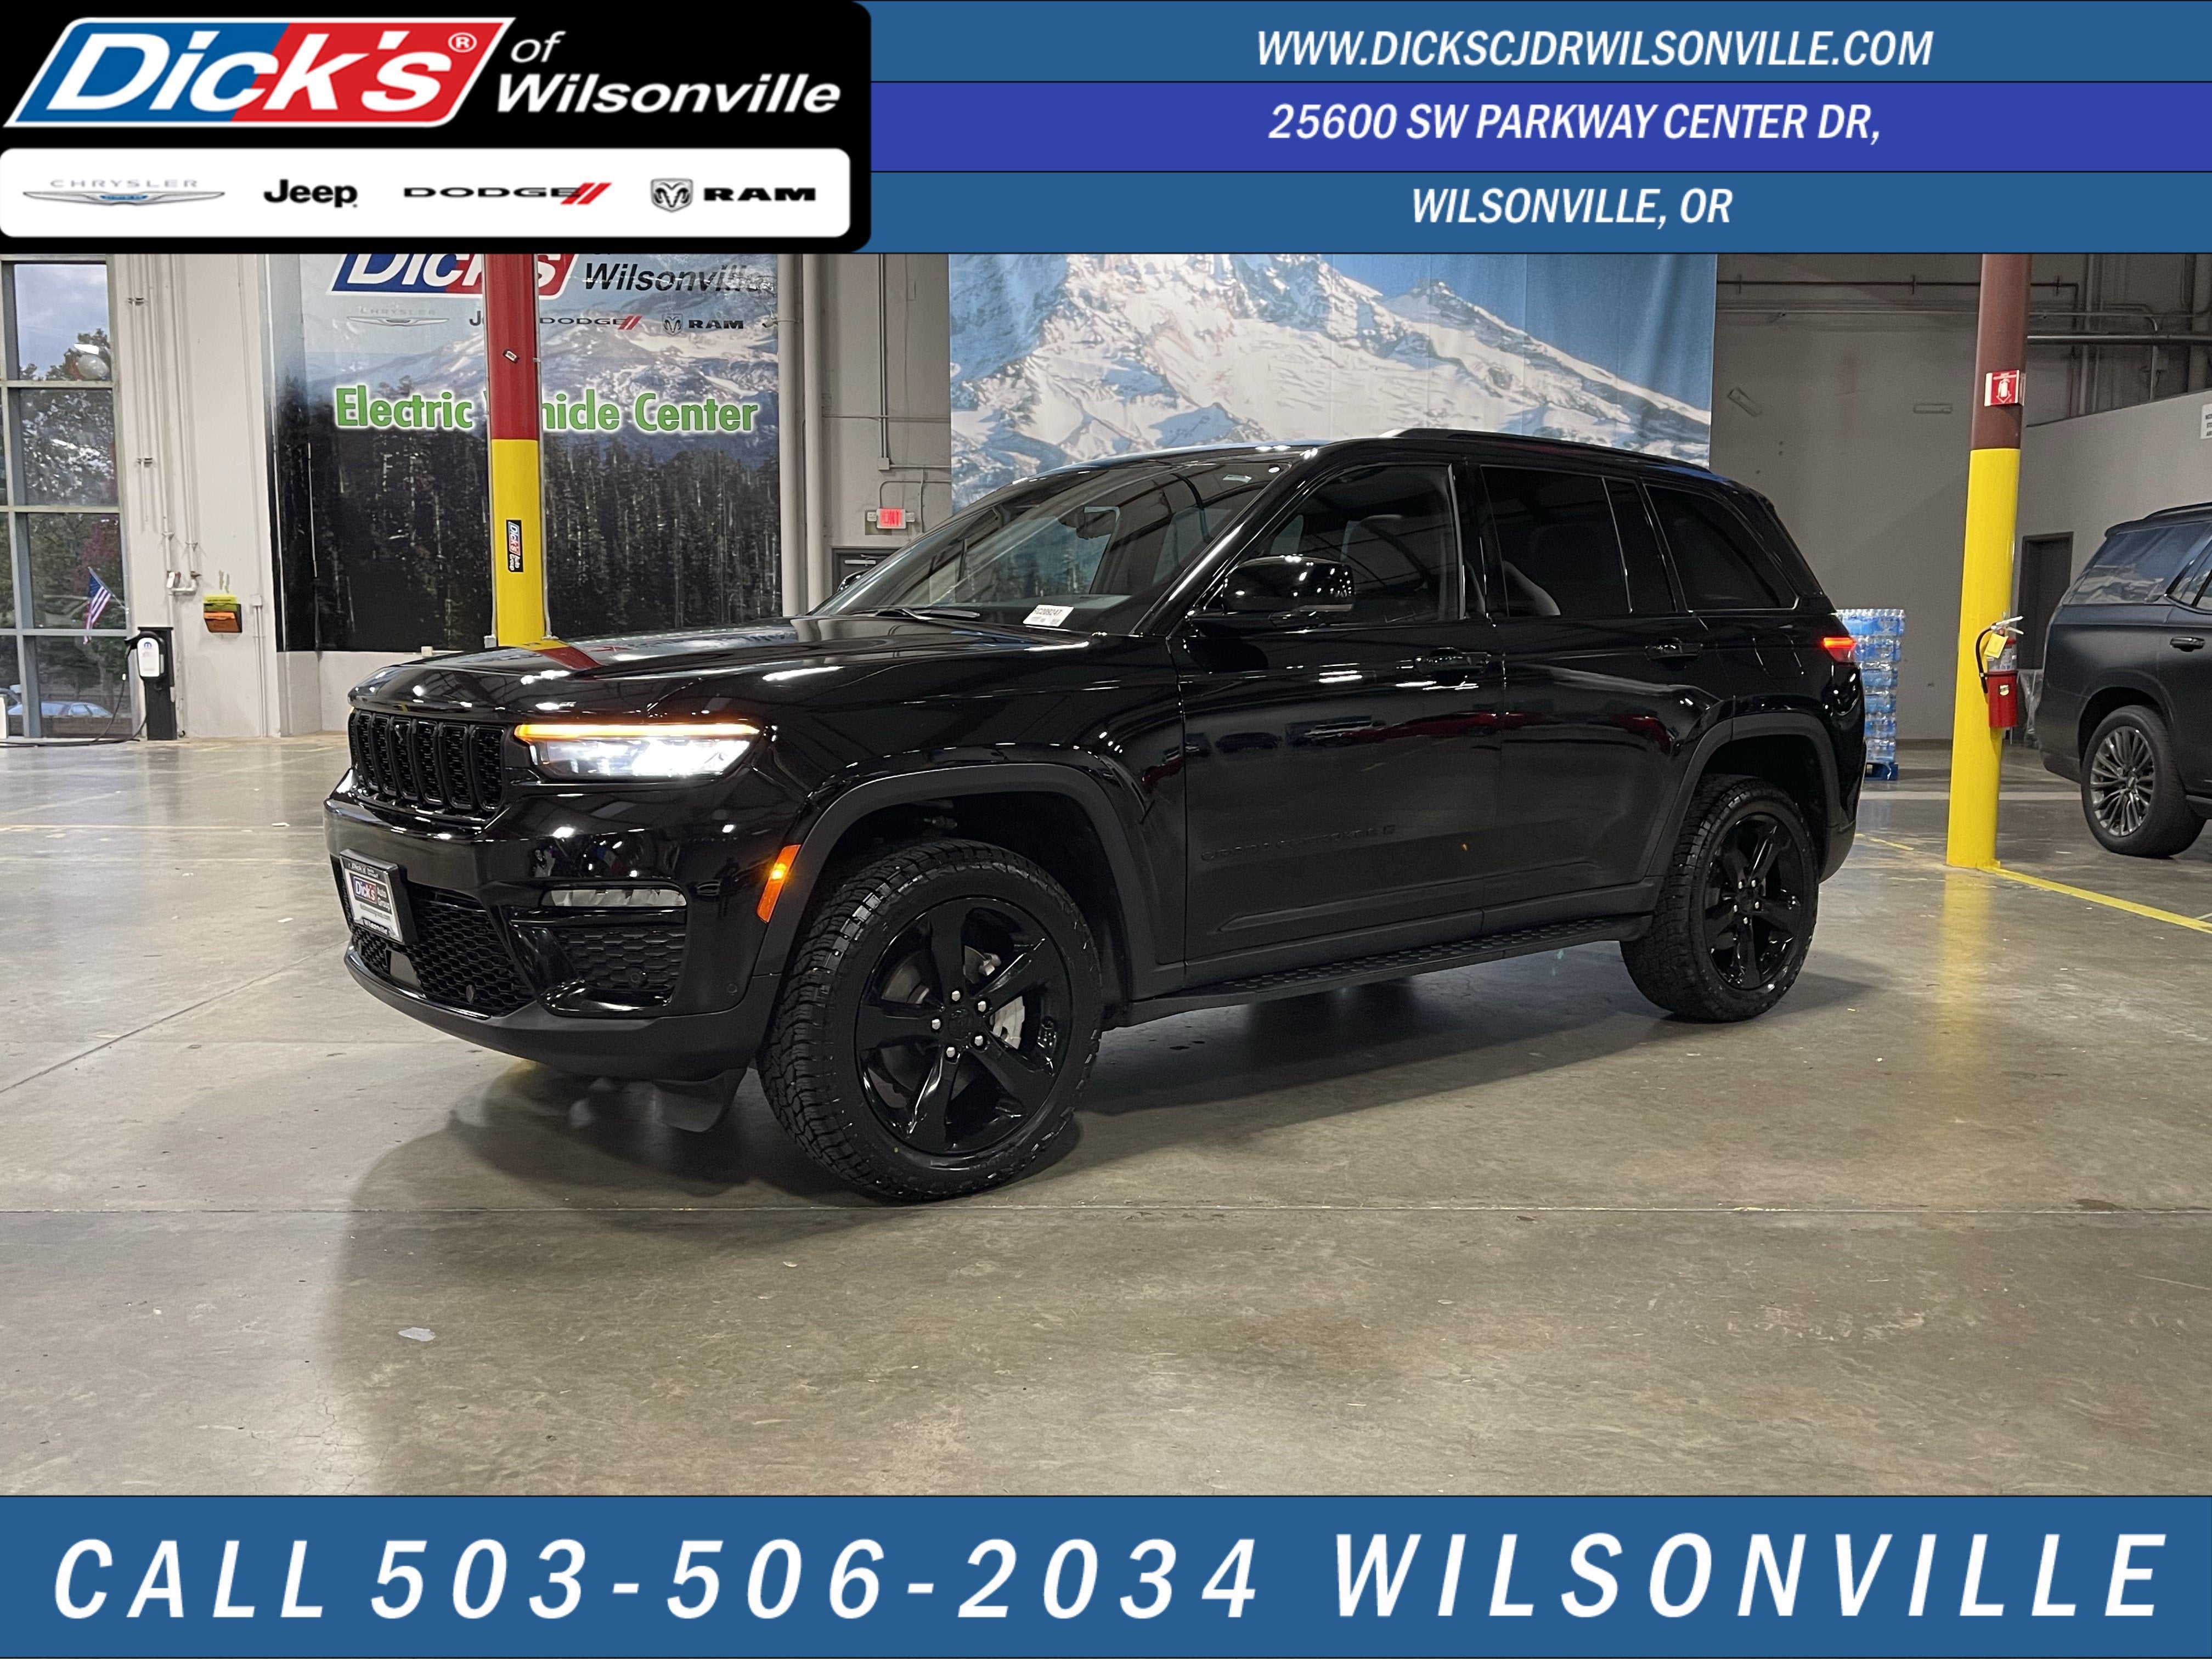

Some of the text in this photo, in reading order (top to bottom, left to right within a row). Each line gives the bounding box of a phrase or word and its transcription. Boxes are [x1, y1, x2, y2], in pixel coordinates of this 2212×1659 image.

[689, 320, 744, 330] RAM
[336, 385, 472, 428] Electric
[635, 392, 758, 431] Center
[355, 880, 376, 901] Dick's
